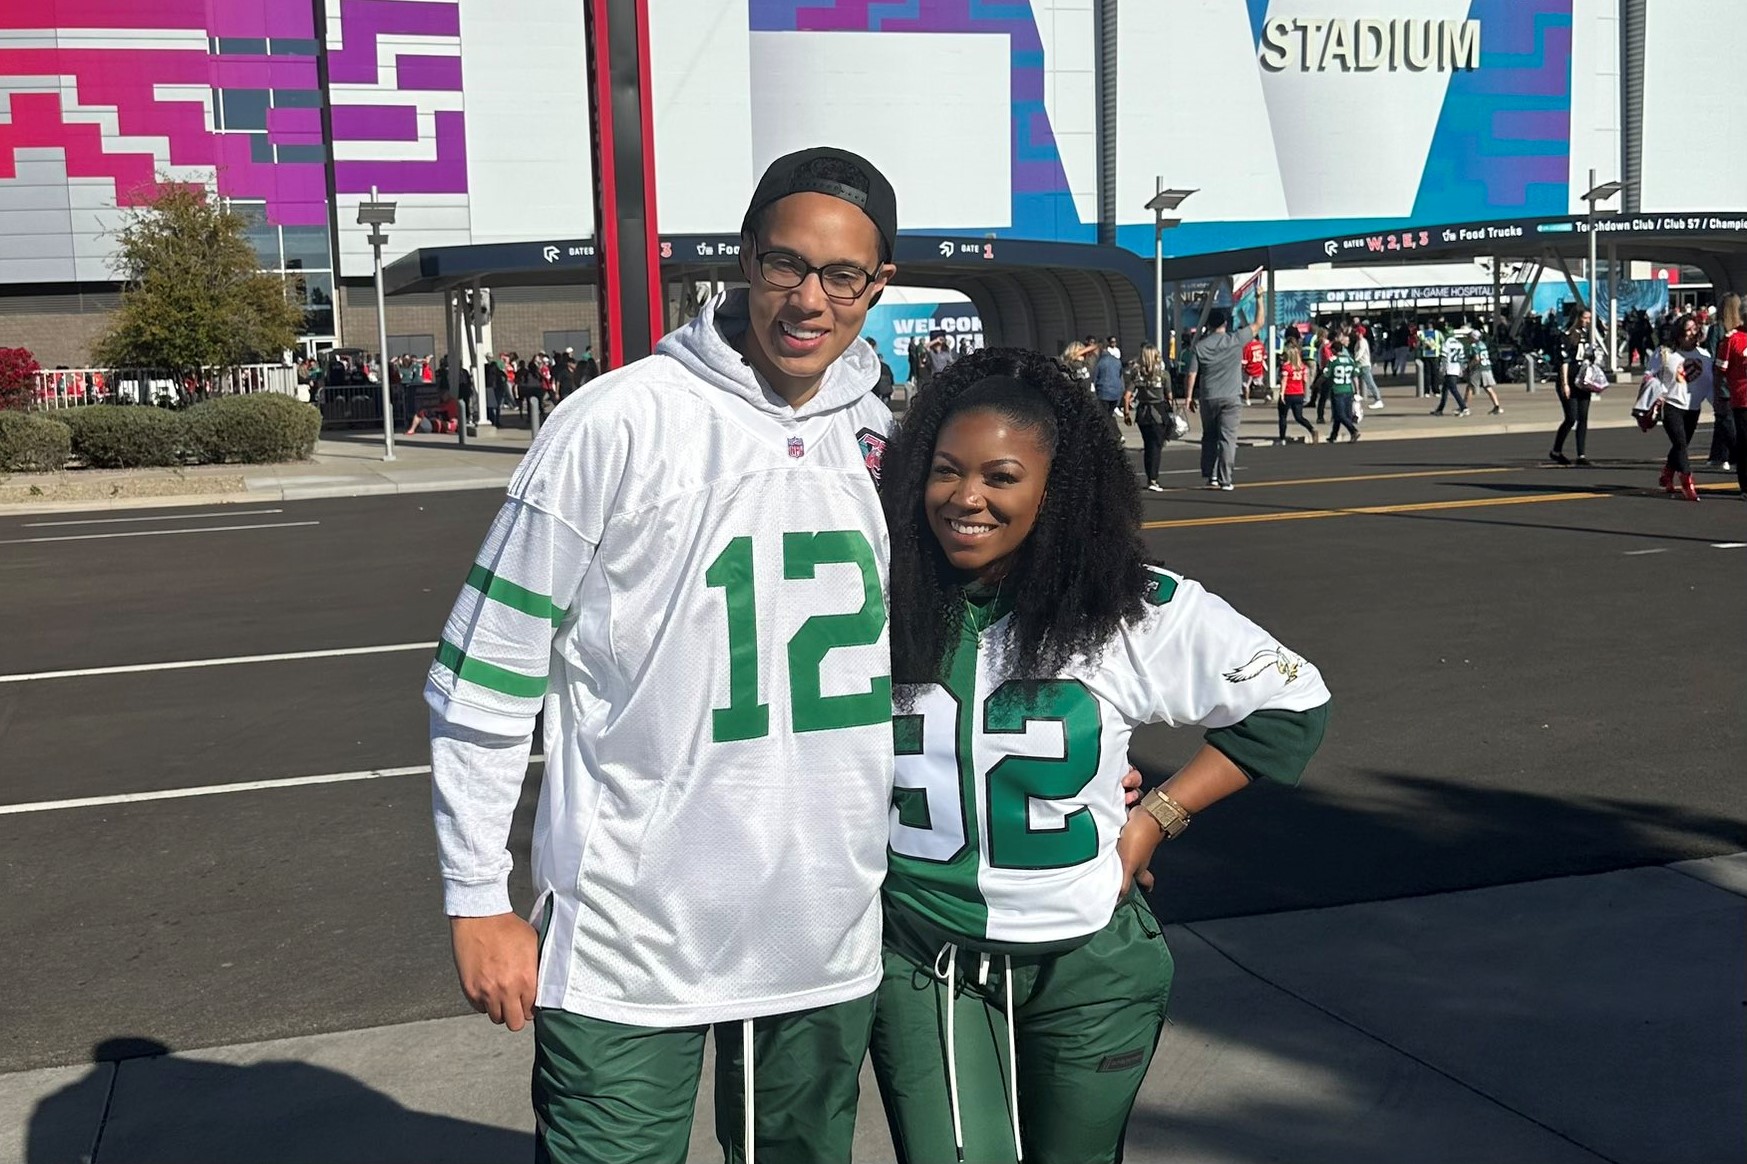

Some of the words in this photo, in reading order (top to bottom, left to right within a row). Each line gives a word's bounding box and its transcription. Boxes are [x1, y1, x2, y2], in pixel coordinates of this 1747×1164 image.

[1260, 17, 1480, 72] STADIUM
[1459, 227, 1485, 240] Food
[1487, 225, 1523, 238] Trucks
[1632, 219, 1655, 231] Club
[1663, 218, 1686, 230] Club
[1687, 218, 1700, 230] 57
[1418, 231, 1429, 246] 3
[569, 246, 594, 255] GATES
[660, 242, 673, 258] 3
[718, 243, 740, 255] Foo
[961, 244, 979, 253] GATE
[983, 243, 994, 259] 1
[1347, 290, 1372, 301] THE
[1373, 288, 1409, 300] FIFTY
[1410, 286, 1450, 298] IN-GAME
[1450, 286, 1505, 297] HOSPITALIY
[1333, 365, 1354, 385] 92
[705, 530, 892, 743] 12
[887, 679, 1102, 870] 92
